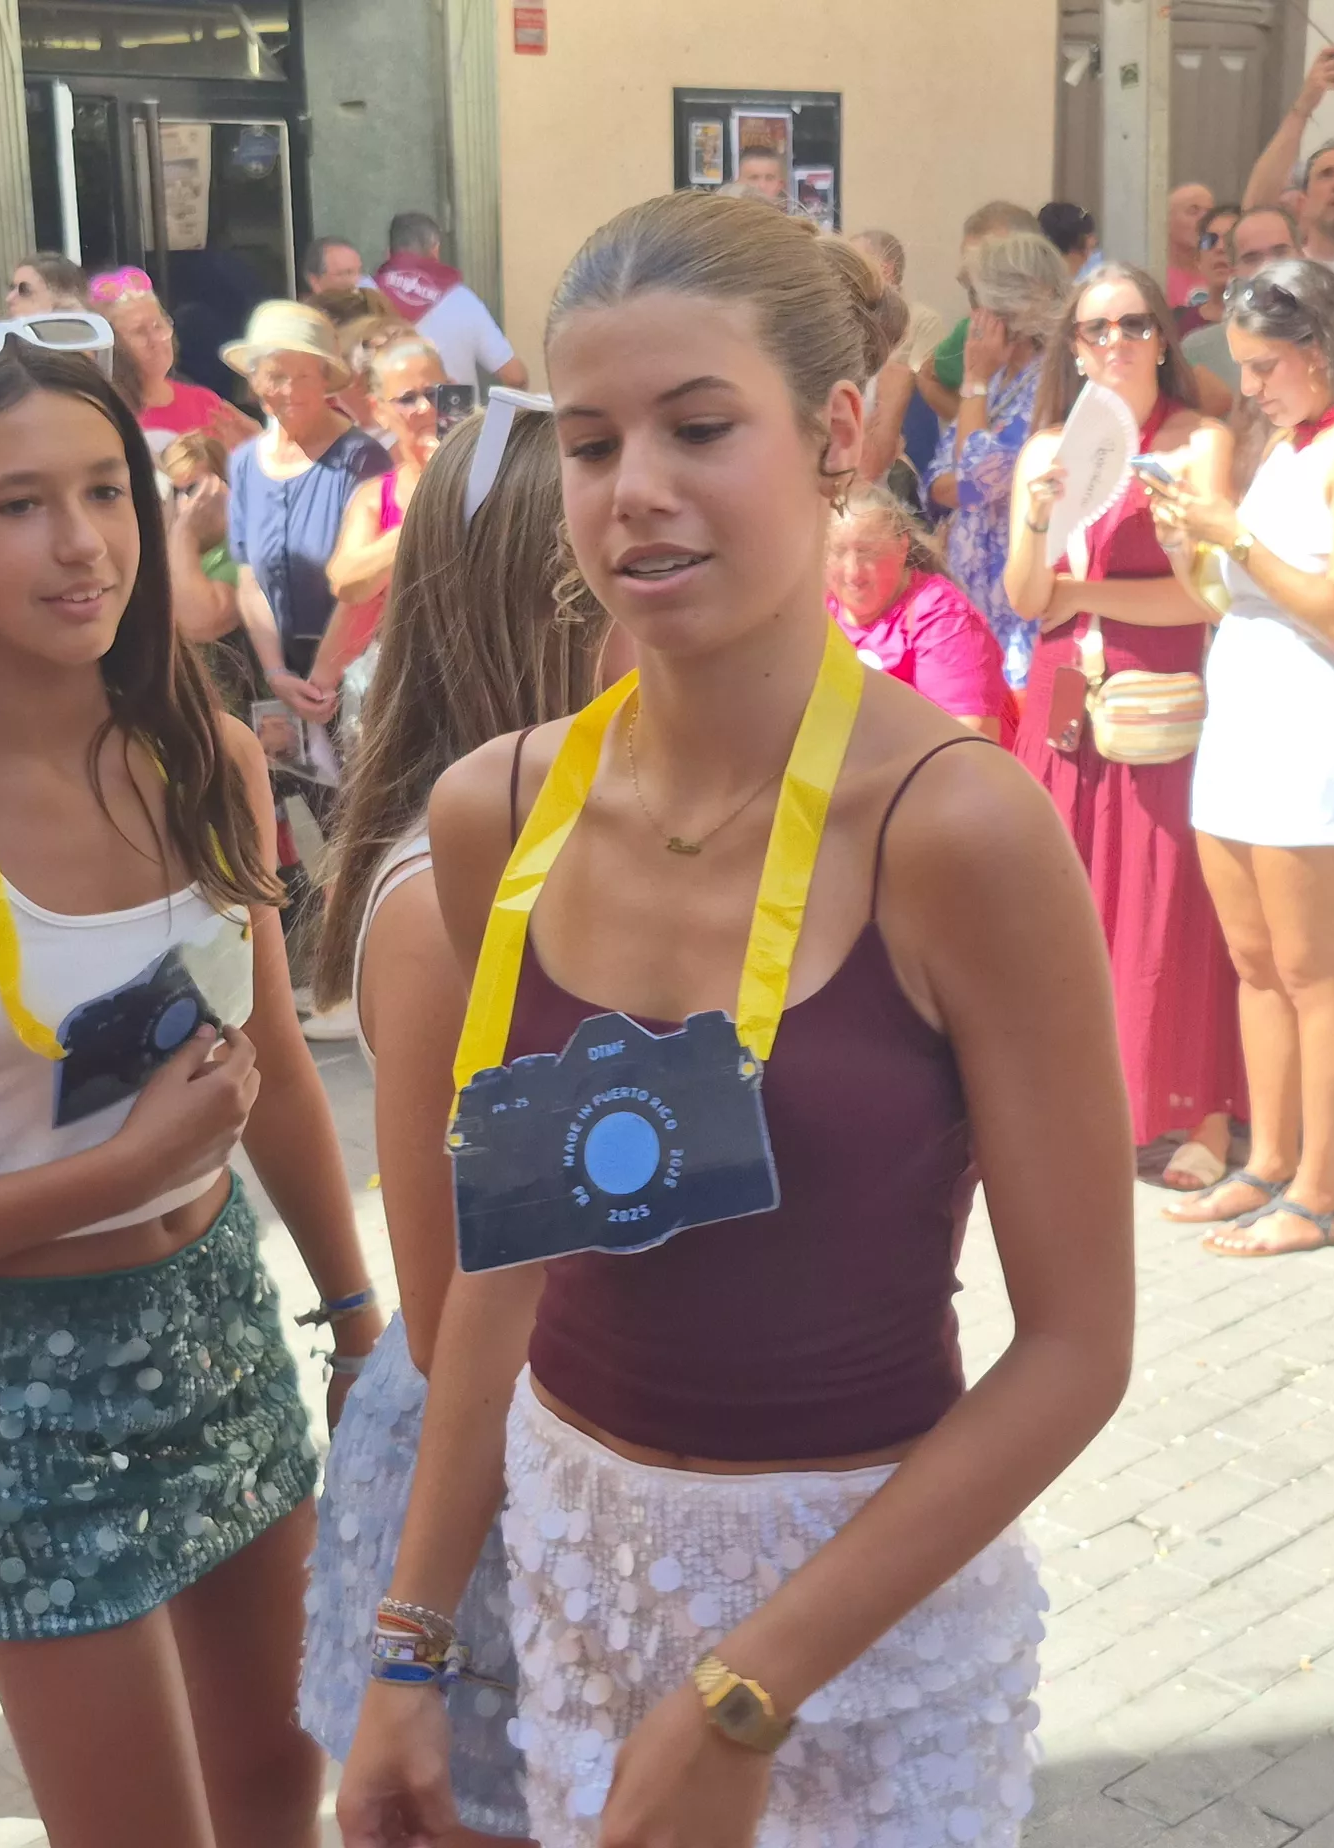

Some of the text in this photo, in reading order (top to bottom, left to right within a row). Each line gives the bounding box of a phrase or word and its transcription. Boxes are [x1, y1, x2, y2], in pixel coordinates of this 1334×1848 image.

[563, 1086, 678, 1167] MADE IN PUERTO RICO
[607, 1203, 651, 1222] 2025
